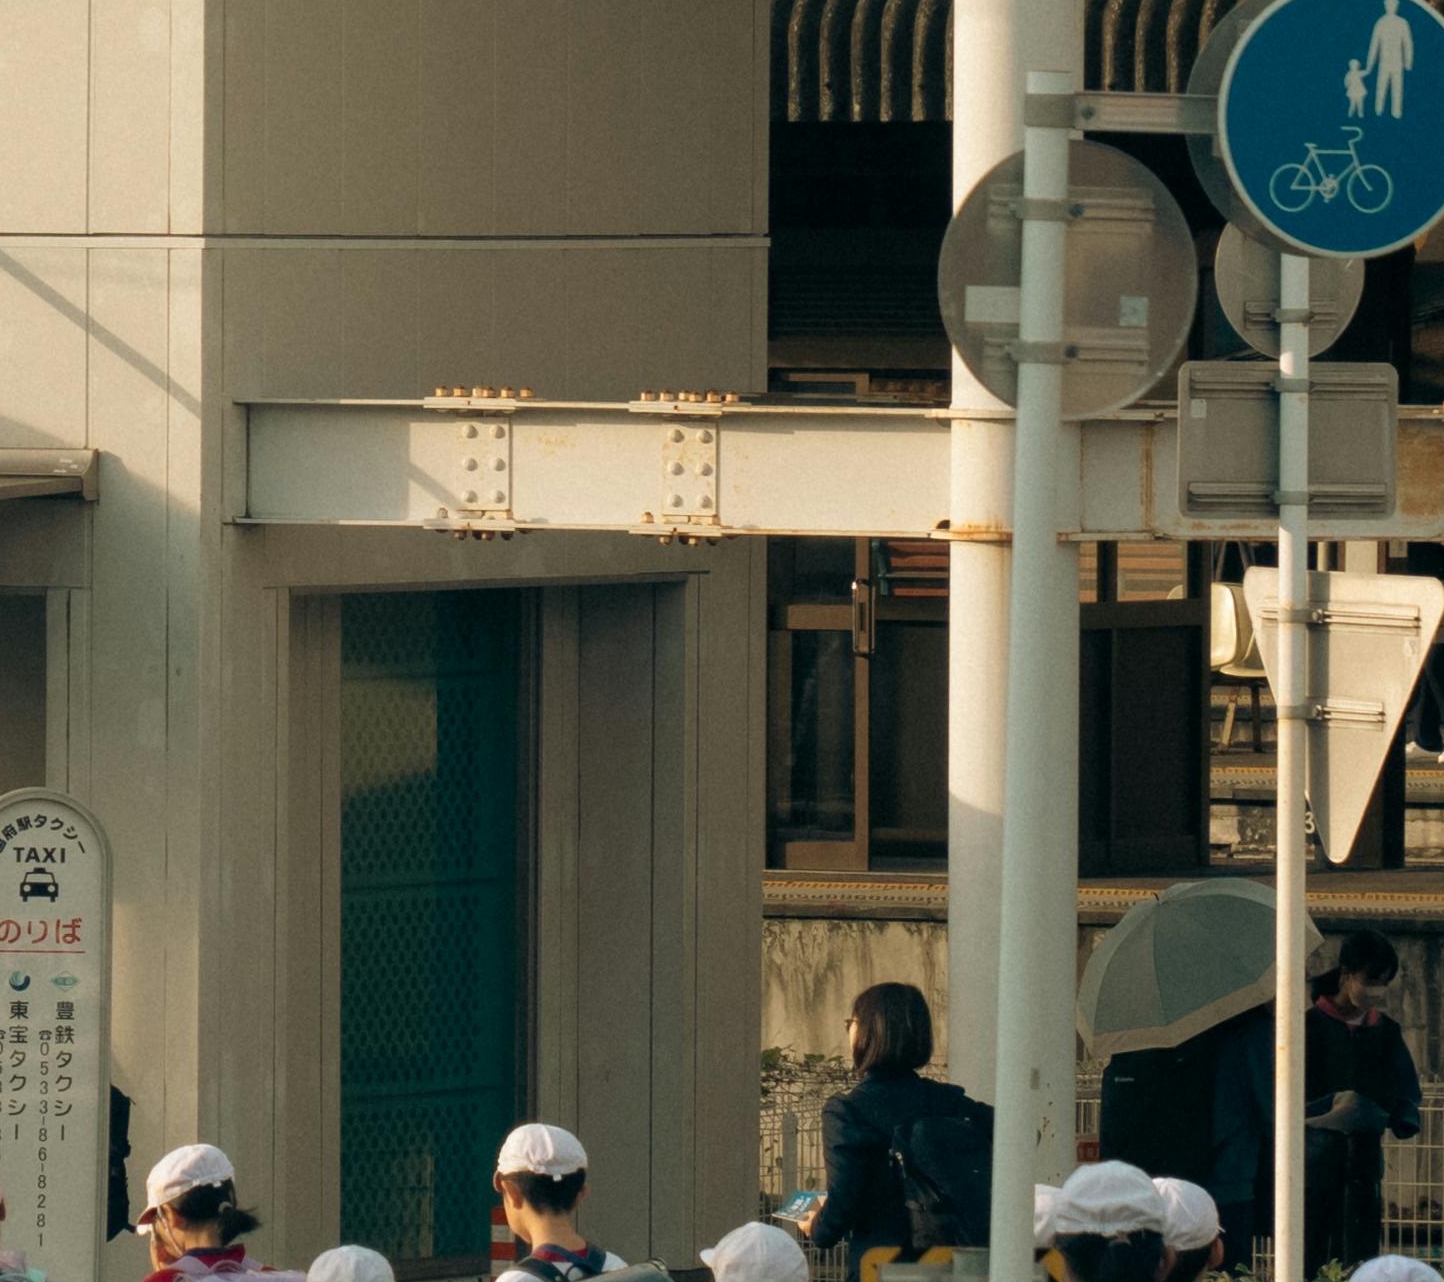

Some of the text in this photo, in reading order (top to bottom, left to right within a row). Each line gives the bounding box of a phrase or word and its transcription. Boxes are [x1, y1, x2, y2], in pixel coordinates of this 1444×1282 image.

[13, 847, 67, 863] TAXI
[8, 1000, 29, 1141] 東宝タクシー
[54, 1001, 75, 1142] 豊鉄タクシー
[36, 1042, 50, 1248] 0533-86-8281
